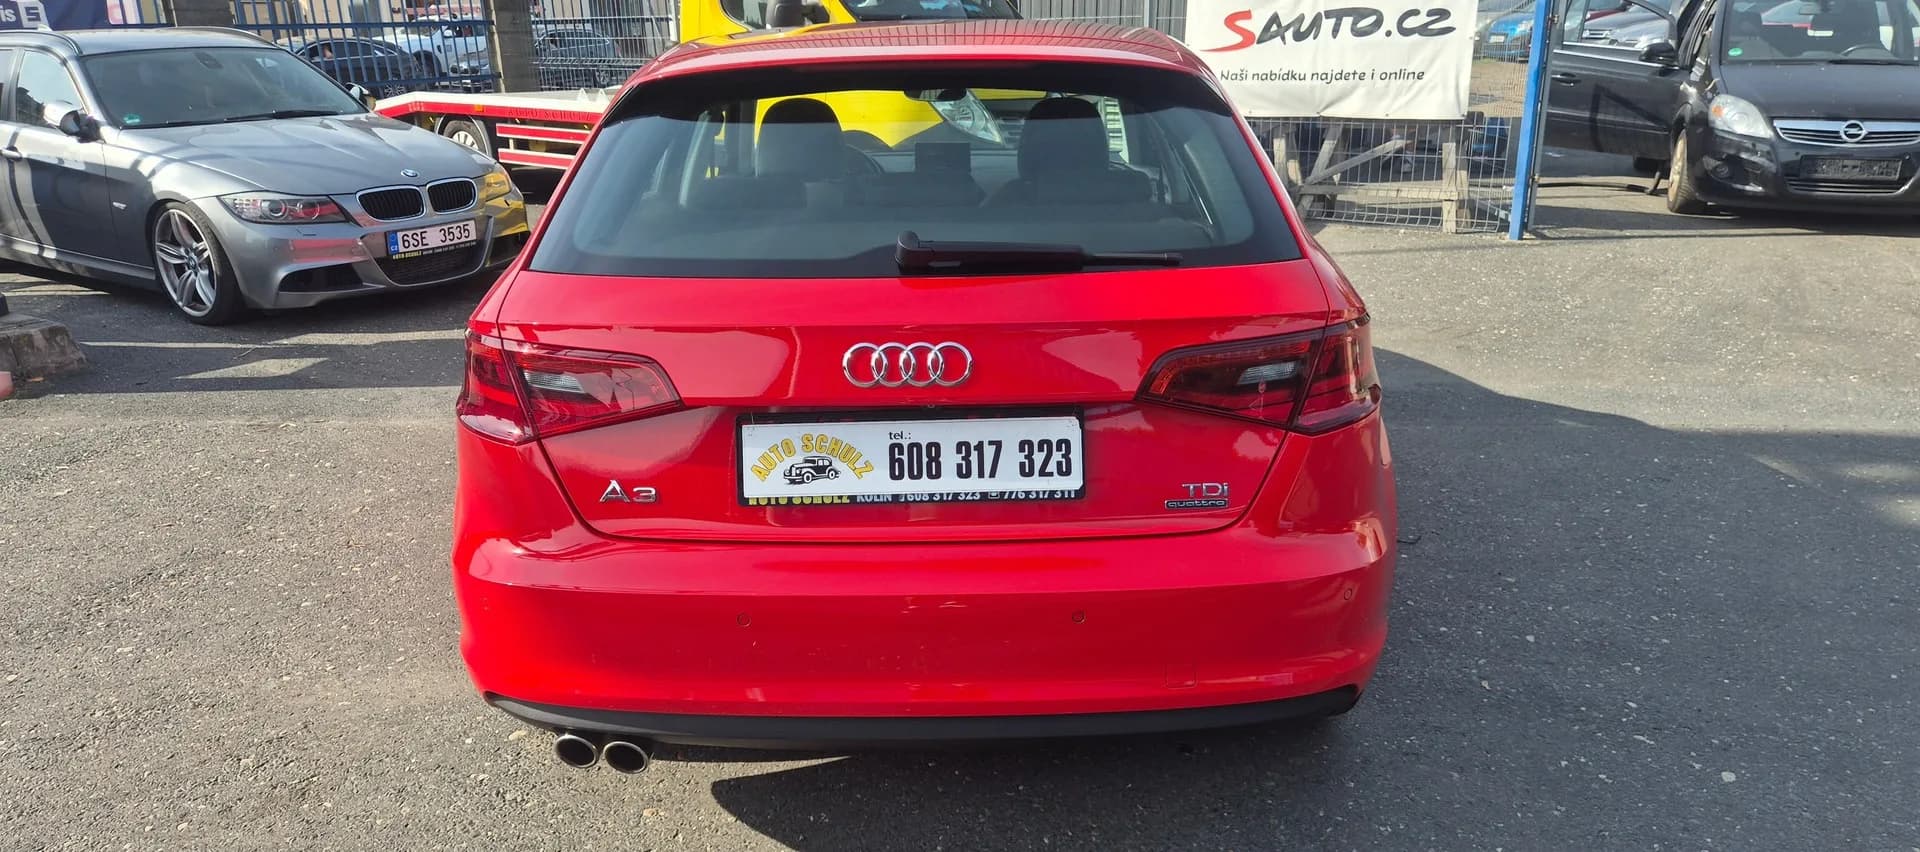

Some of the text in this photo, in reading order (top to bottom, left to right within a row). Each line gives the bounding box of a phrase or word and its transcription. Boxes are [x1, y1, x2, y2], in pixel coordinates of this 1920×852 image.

[1200, 7, 1456, 51] SAUTO.CZ
[1220, 67, 1425, 85] Naši nabídku najdete i online
[402, 231, 429, 249] 6SE
[439, 224, 471, 243] 3535
[888, 430, 913, 441] tel.:
[751, 433, 874, 482] AUTO SCHULZ
[888, 438, 1073, 481] 608 317 323
[600, 479, 656, 503] A3
